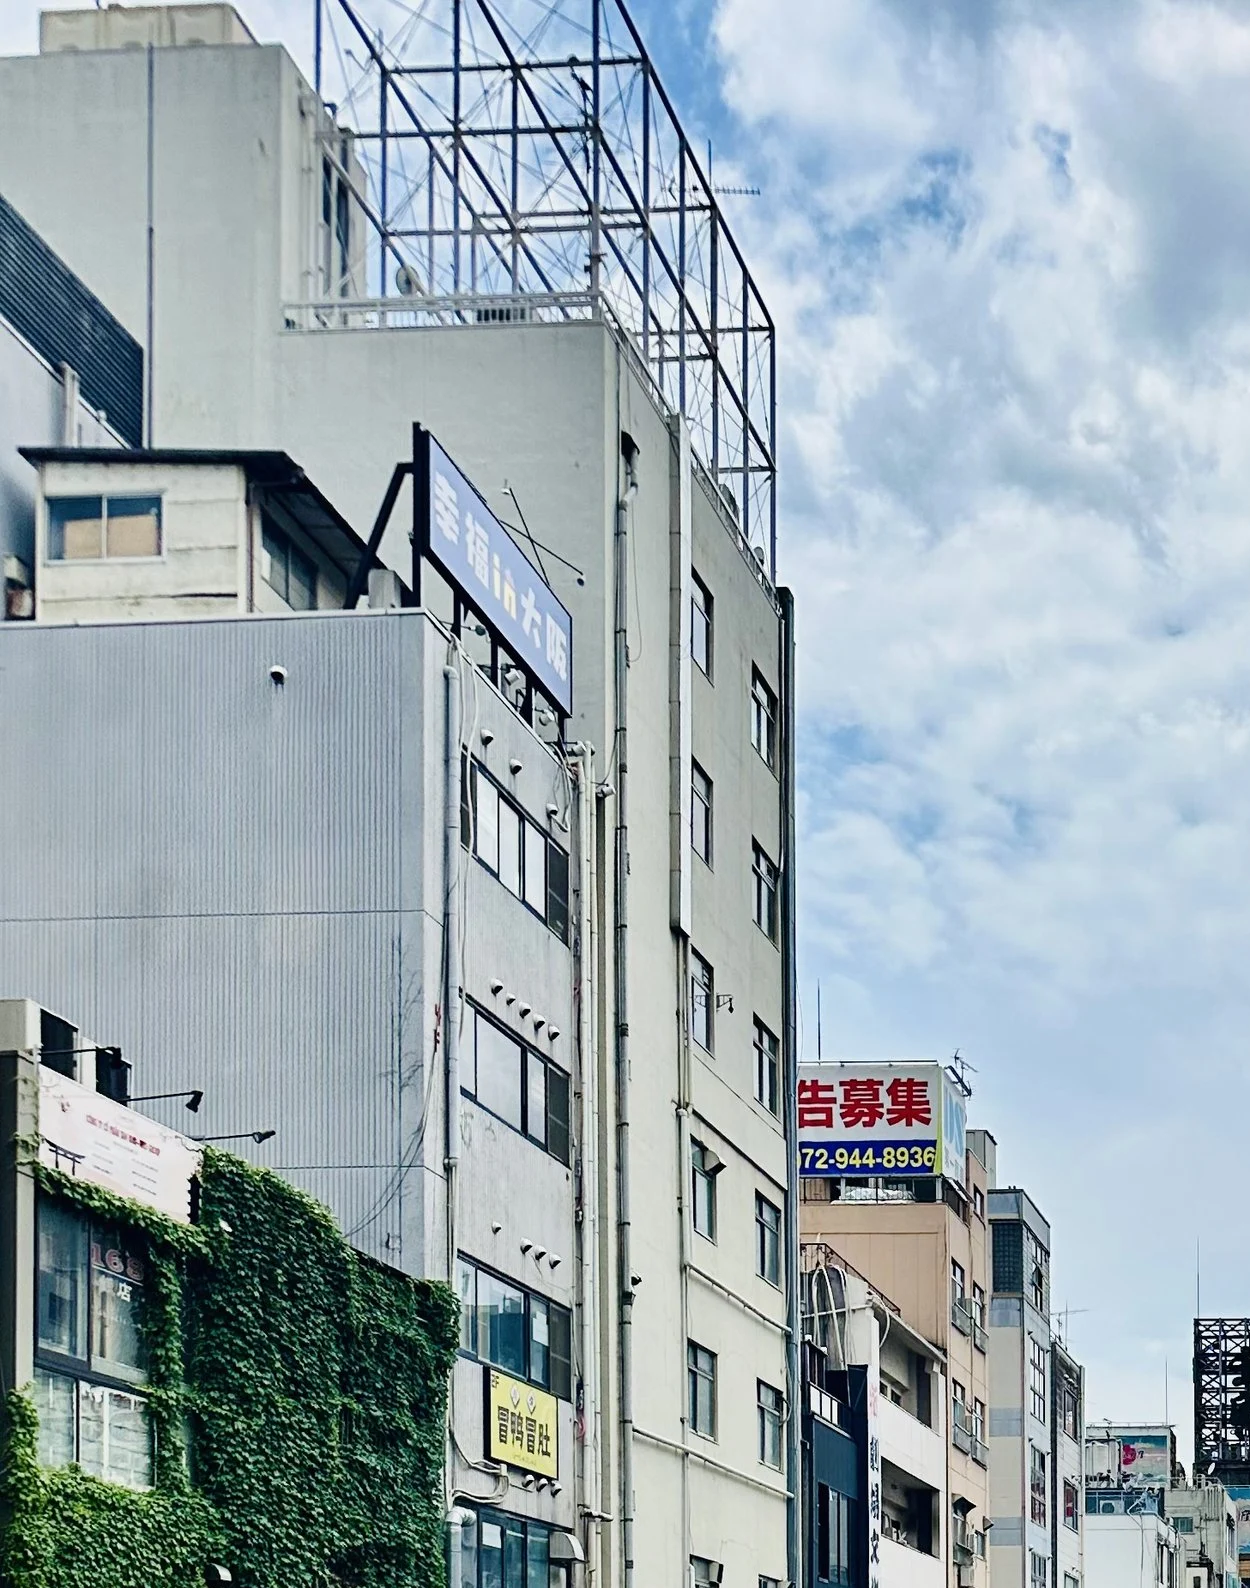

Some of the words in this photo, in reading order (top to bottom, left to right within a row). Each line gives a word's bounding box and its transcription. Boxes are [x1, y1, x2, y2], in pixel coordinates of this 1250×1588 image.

[434, 472, 567, 681] 幸福in大阪
[798, 1078, 932, 1129] 告募集
[798, 1146, 935, 1170] 72-944-8936
